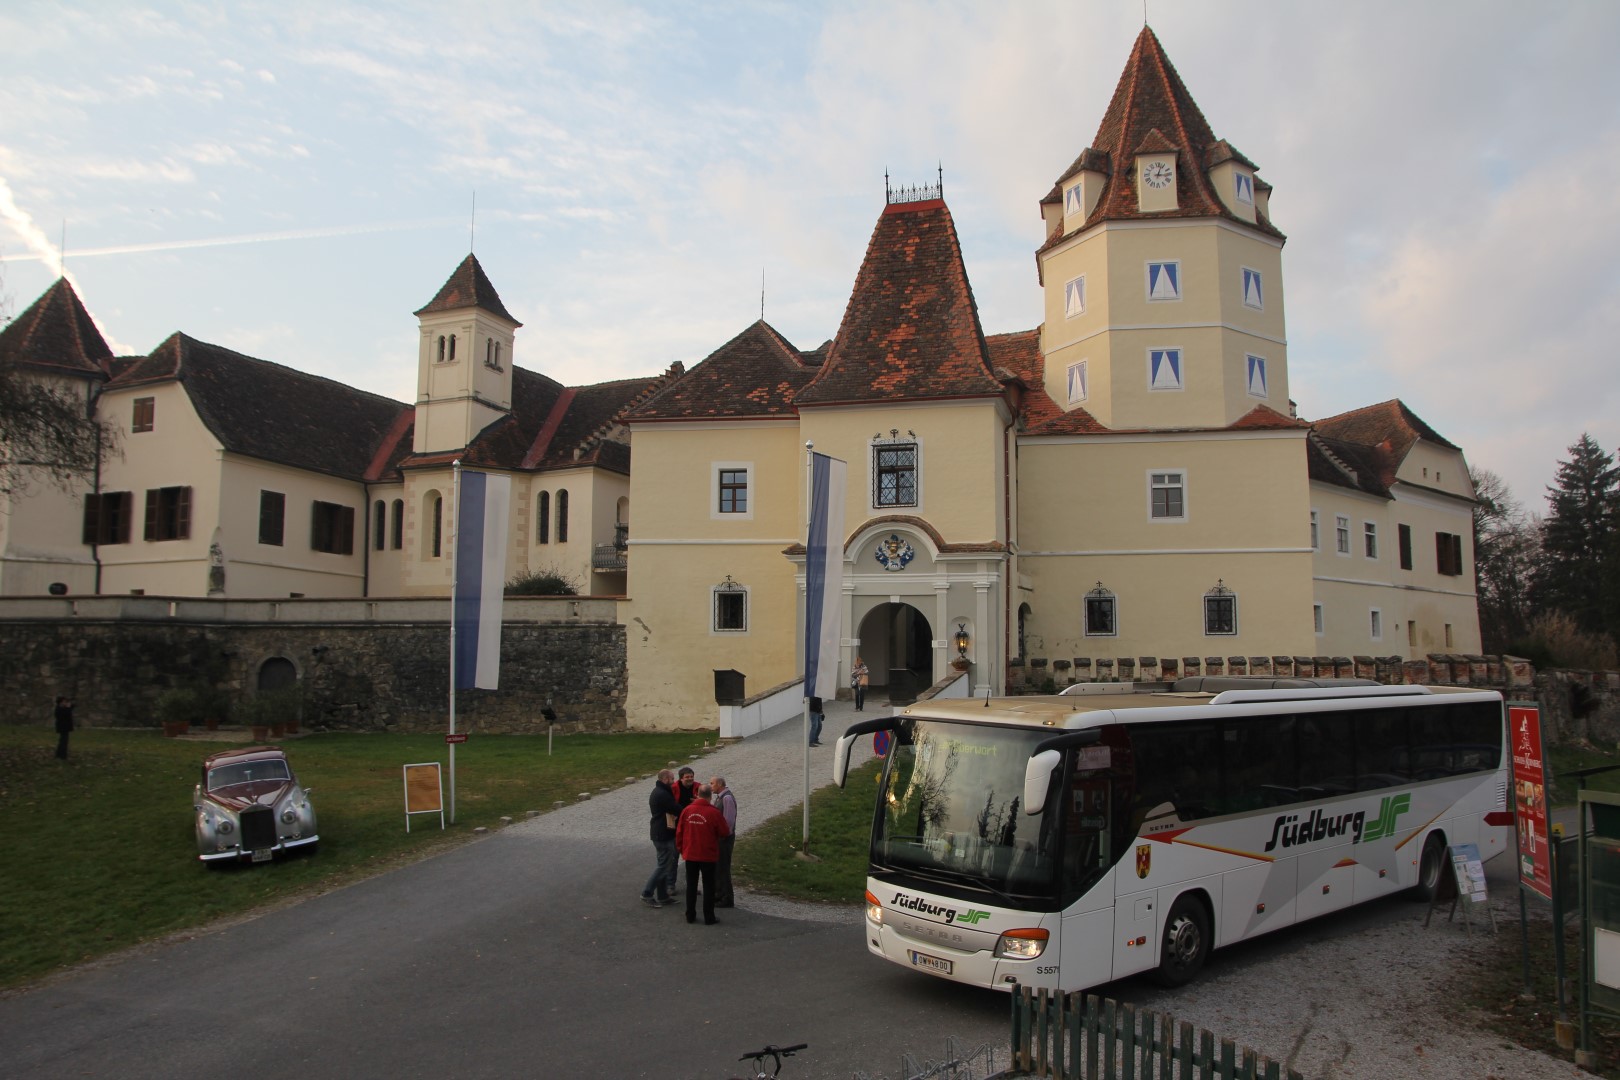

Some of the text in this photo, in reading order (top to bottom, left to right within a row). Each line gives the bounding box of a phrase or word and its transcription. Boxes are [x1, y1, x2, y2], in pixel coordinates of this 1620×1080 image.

[1150, 823, 1175, 832] SETRA
[1265, 809, 1365, 852] Südburg
[891, 893, 956, 923] Südburg
[903, 921, 963, 943] SETRA
